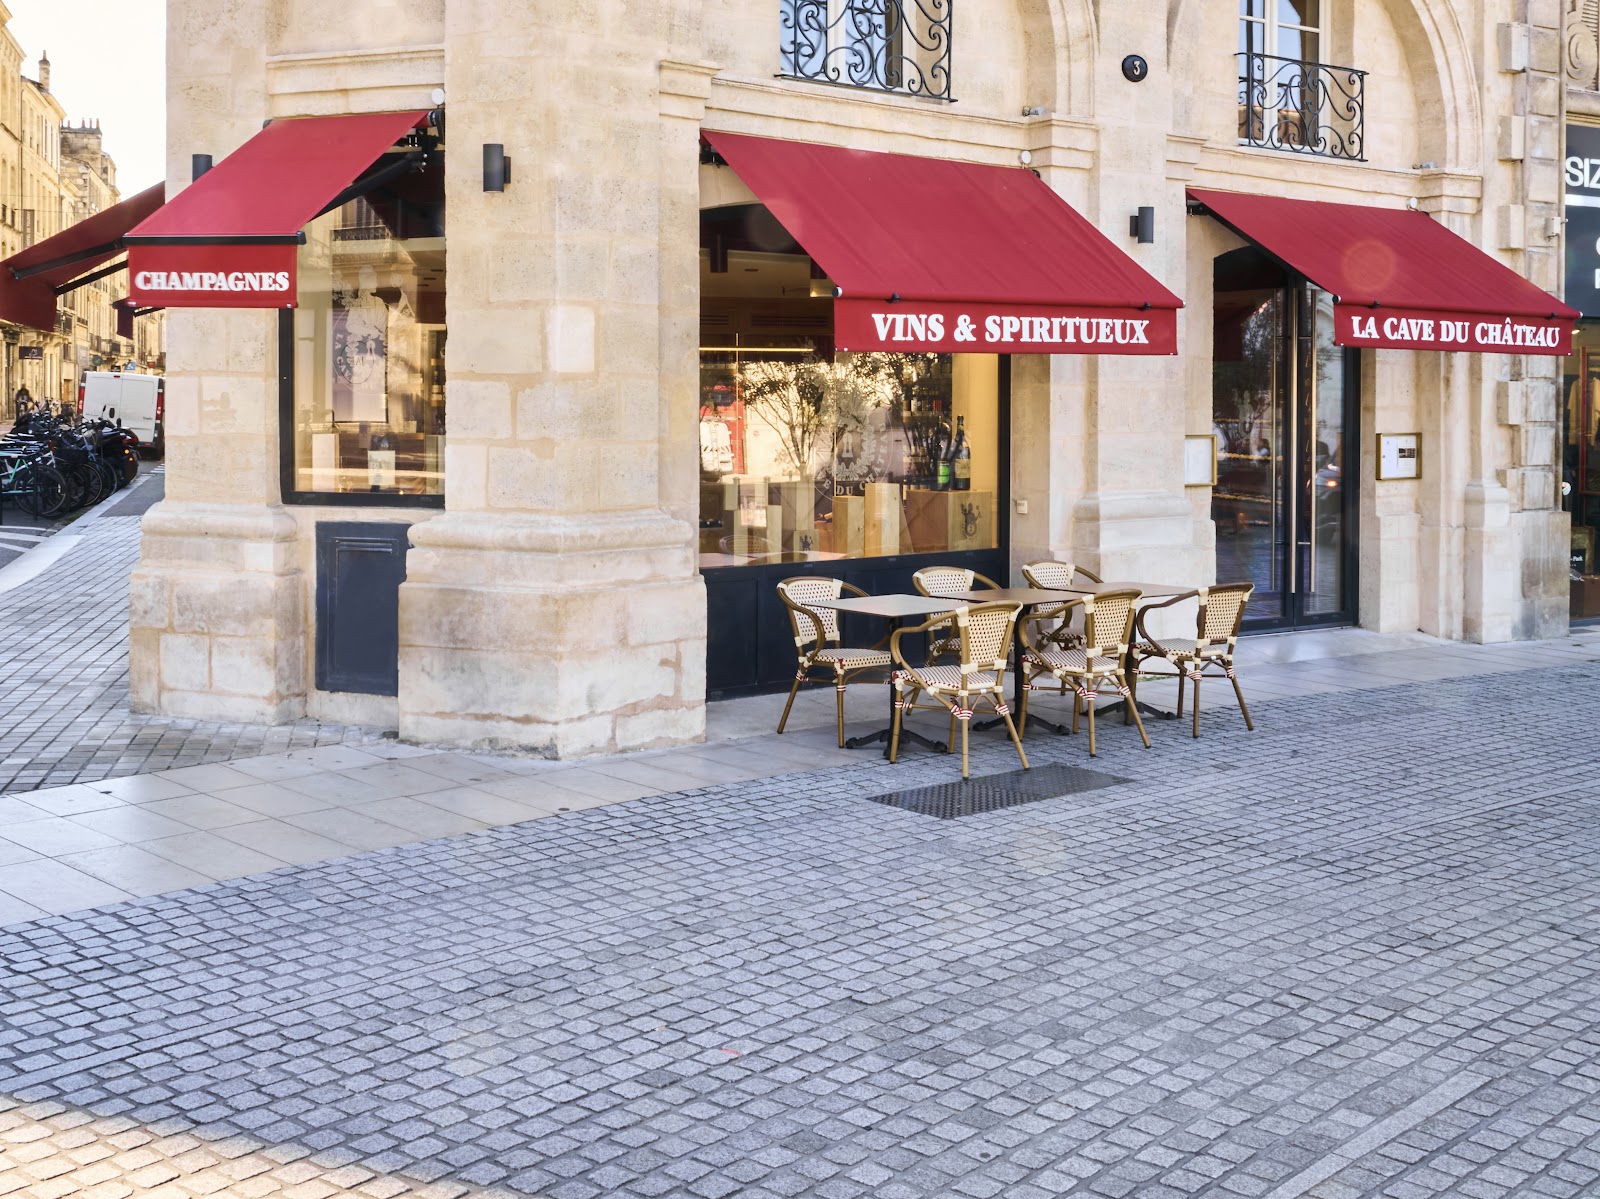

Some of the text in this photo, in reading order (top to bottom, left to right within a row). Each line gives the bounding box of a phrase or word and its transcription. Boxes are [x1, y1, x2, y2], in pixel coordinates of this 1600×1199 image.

[1133, 60, 1141, 76] 3
[135, 270, 290, 292] CHAMPAGNES
[871, 313, 1150, 345] VINS & SPIRITUEUX
[1351, 316, 1561, 348] LA CAVE DU CHÂTEAU
[836, 484, 854, 496] DU
